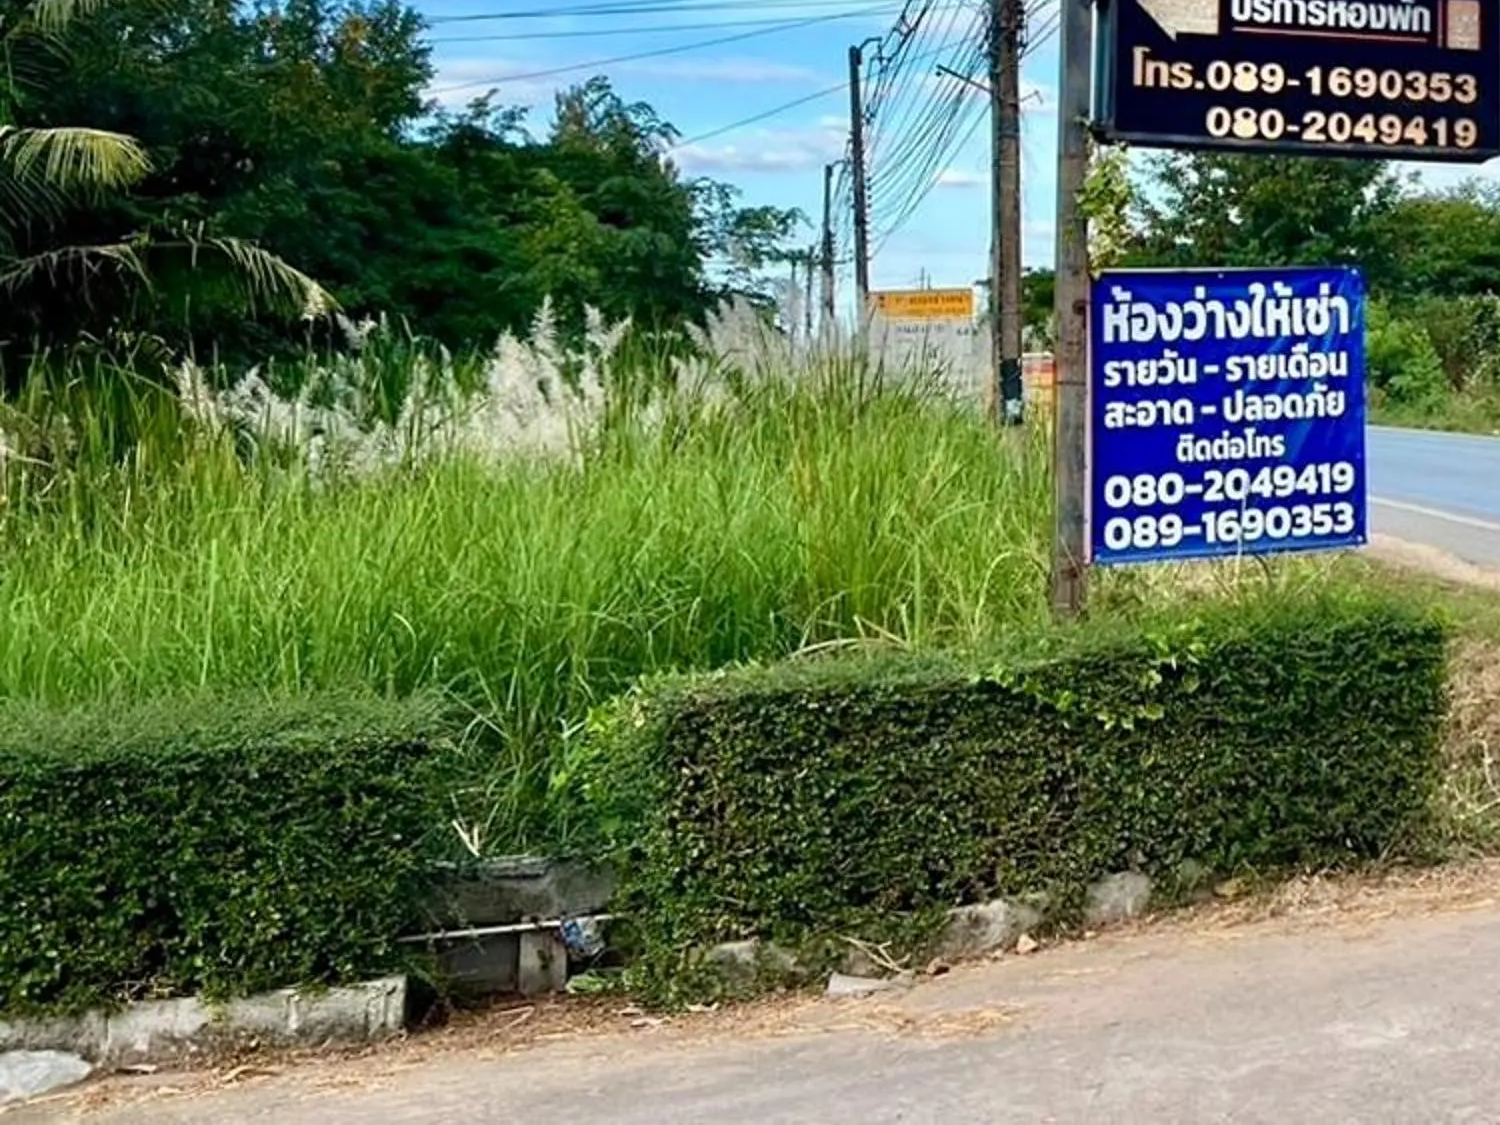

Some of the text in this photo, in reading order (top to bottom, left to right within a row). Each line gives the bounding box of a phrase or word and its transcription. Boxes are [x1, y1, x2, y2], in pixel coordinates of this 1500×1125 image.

[1205, 106, 1478, 148] 080-2049419
[1102, 281, 1350, 343] ห้องว่างให้เช่า
[1103, 348, 1197, 387] รายวัน
[1225, 342, 1348, 381] รายเดือน
[1104, 398, 1194, 429] สะอาด
[1222, 382, 1345, 423] ปลอดภัย
[1176, 427, 1285, 463] ติดต่อโทร
[1103, 461, 1355, 508] 080-2049419
[1103, 501, 1355, 550] 089-1690353
